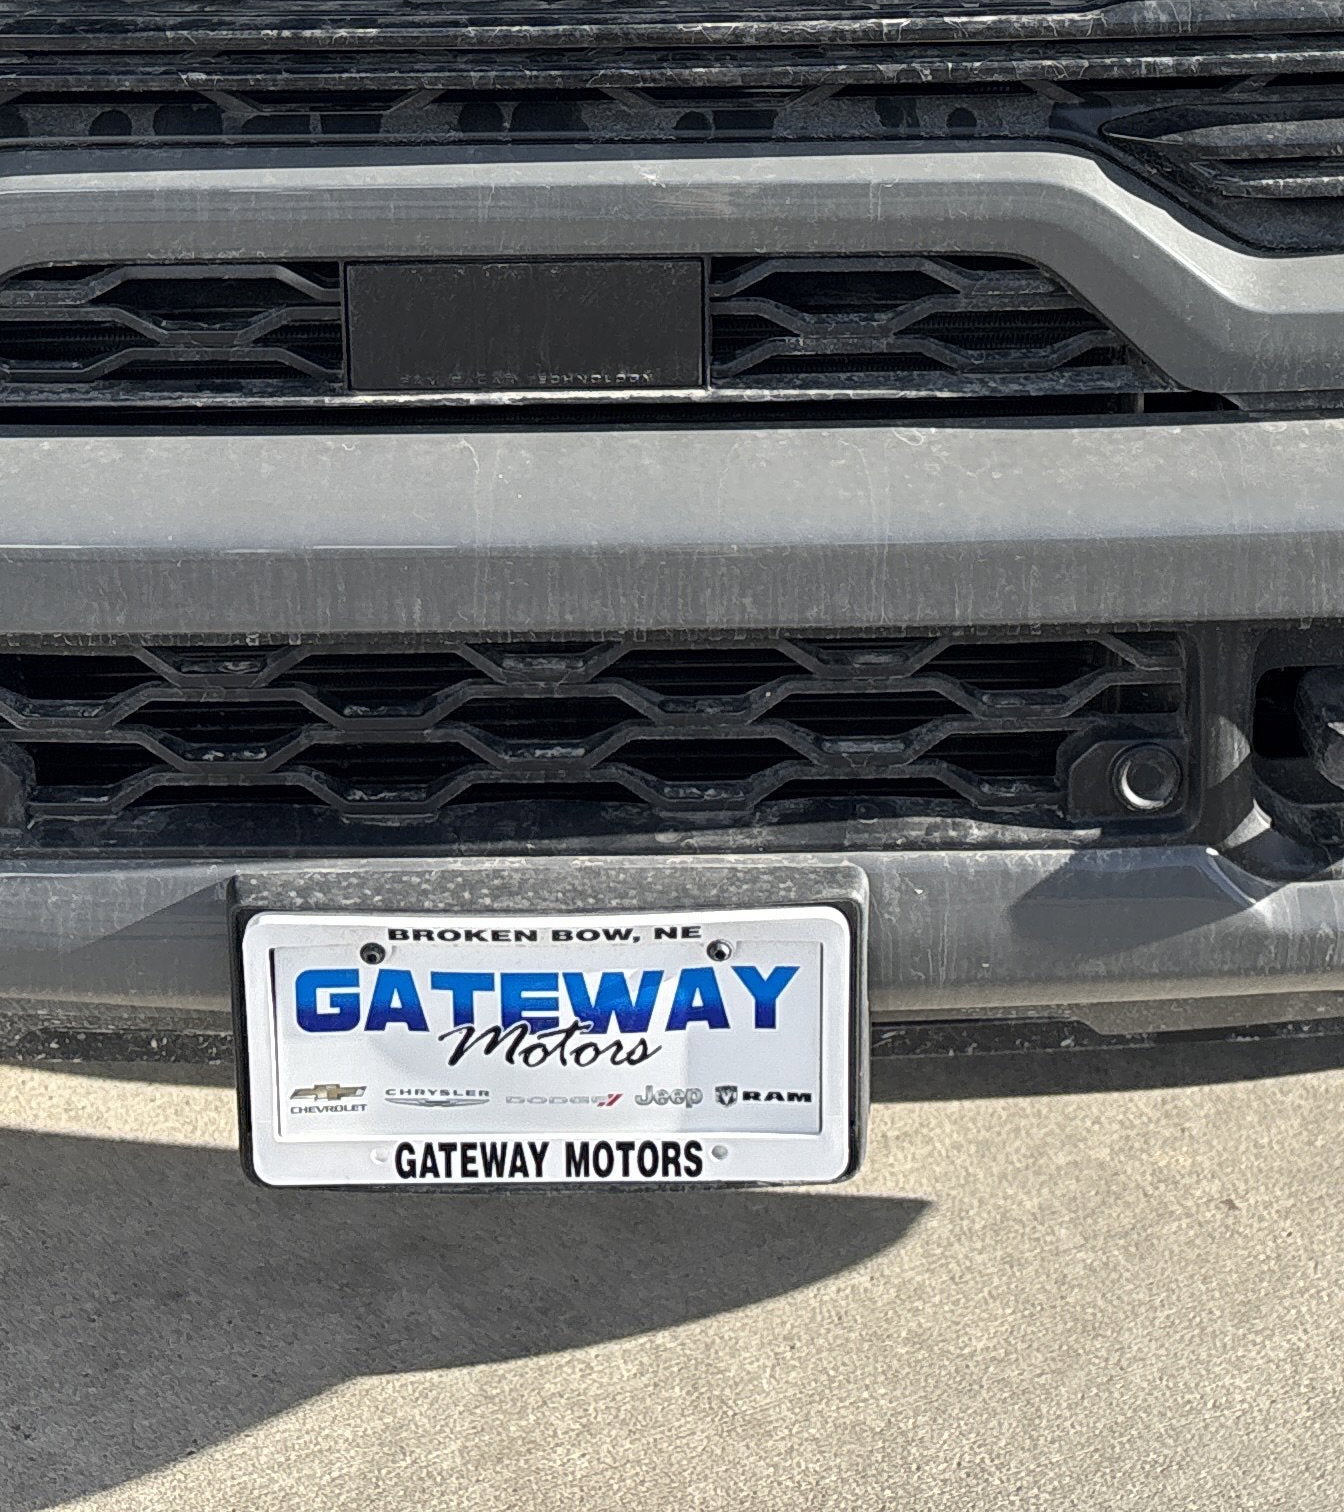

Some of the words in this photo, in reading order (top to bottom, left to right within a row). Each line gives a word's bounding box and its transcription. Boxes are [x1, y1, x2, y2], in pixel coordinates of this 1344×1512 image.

[387, 928, 538, 943] BROKEN
[551, 927, 640, 944] BOW,
[654, 925, 703, 940] NE
[294, 965, 802, 1035] GATEWAY
[437, 1019, 663, 1069] Motors
[385, 1088, 490, 1097] CHRYSLER
[634, 1084, 704, 1109] Jeep
[742, 1090, 813, 1104] RAM
[290, 1103, 368, 1115] CHEVROLET
[394, 1142, 551, 1179] GATEWAY
[565, 1140, 704, 1179] MOTORS
